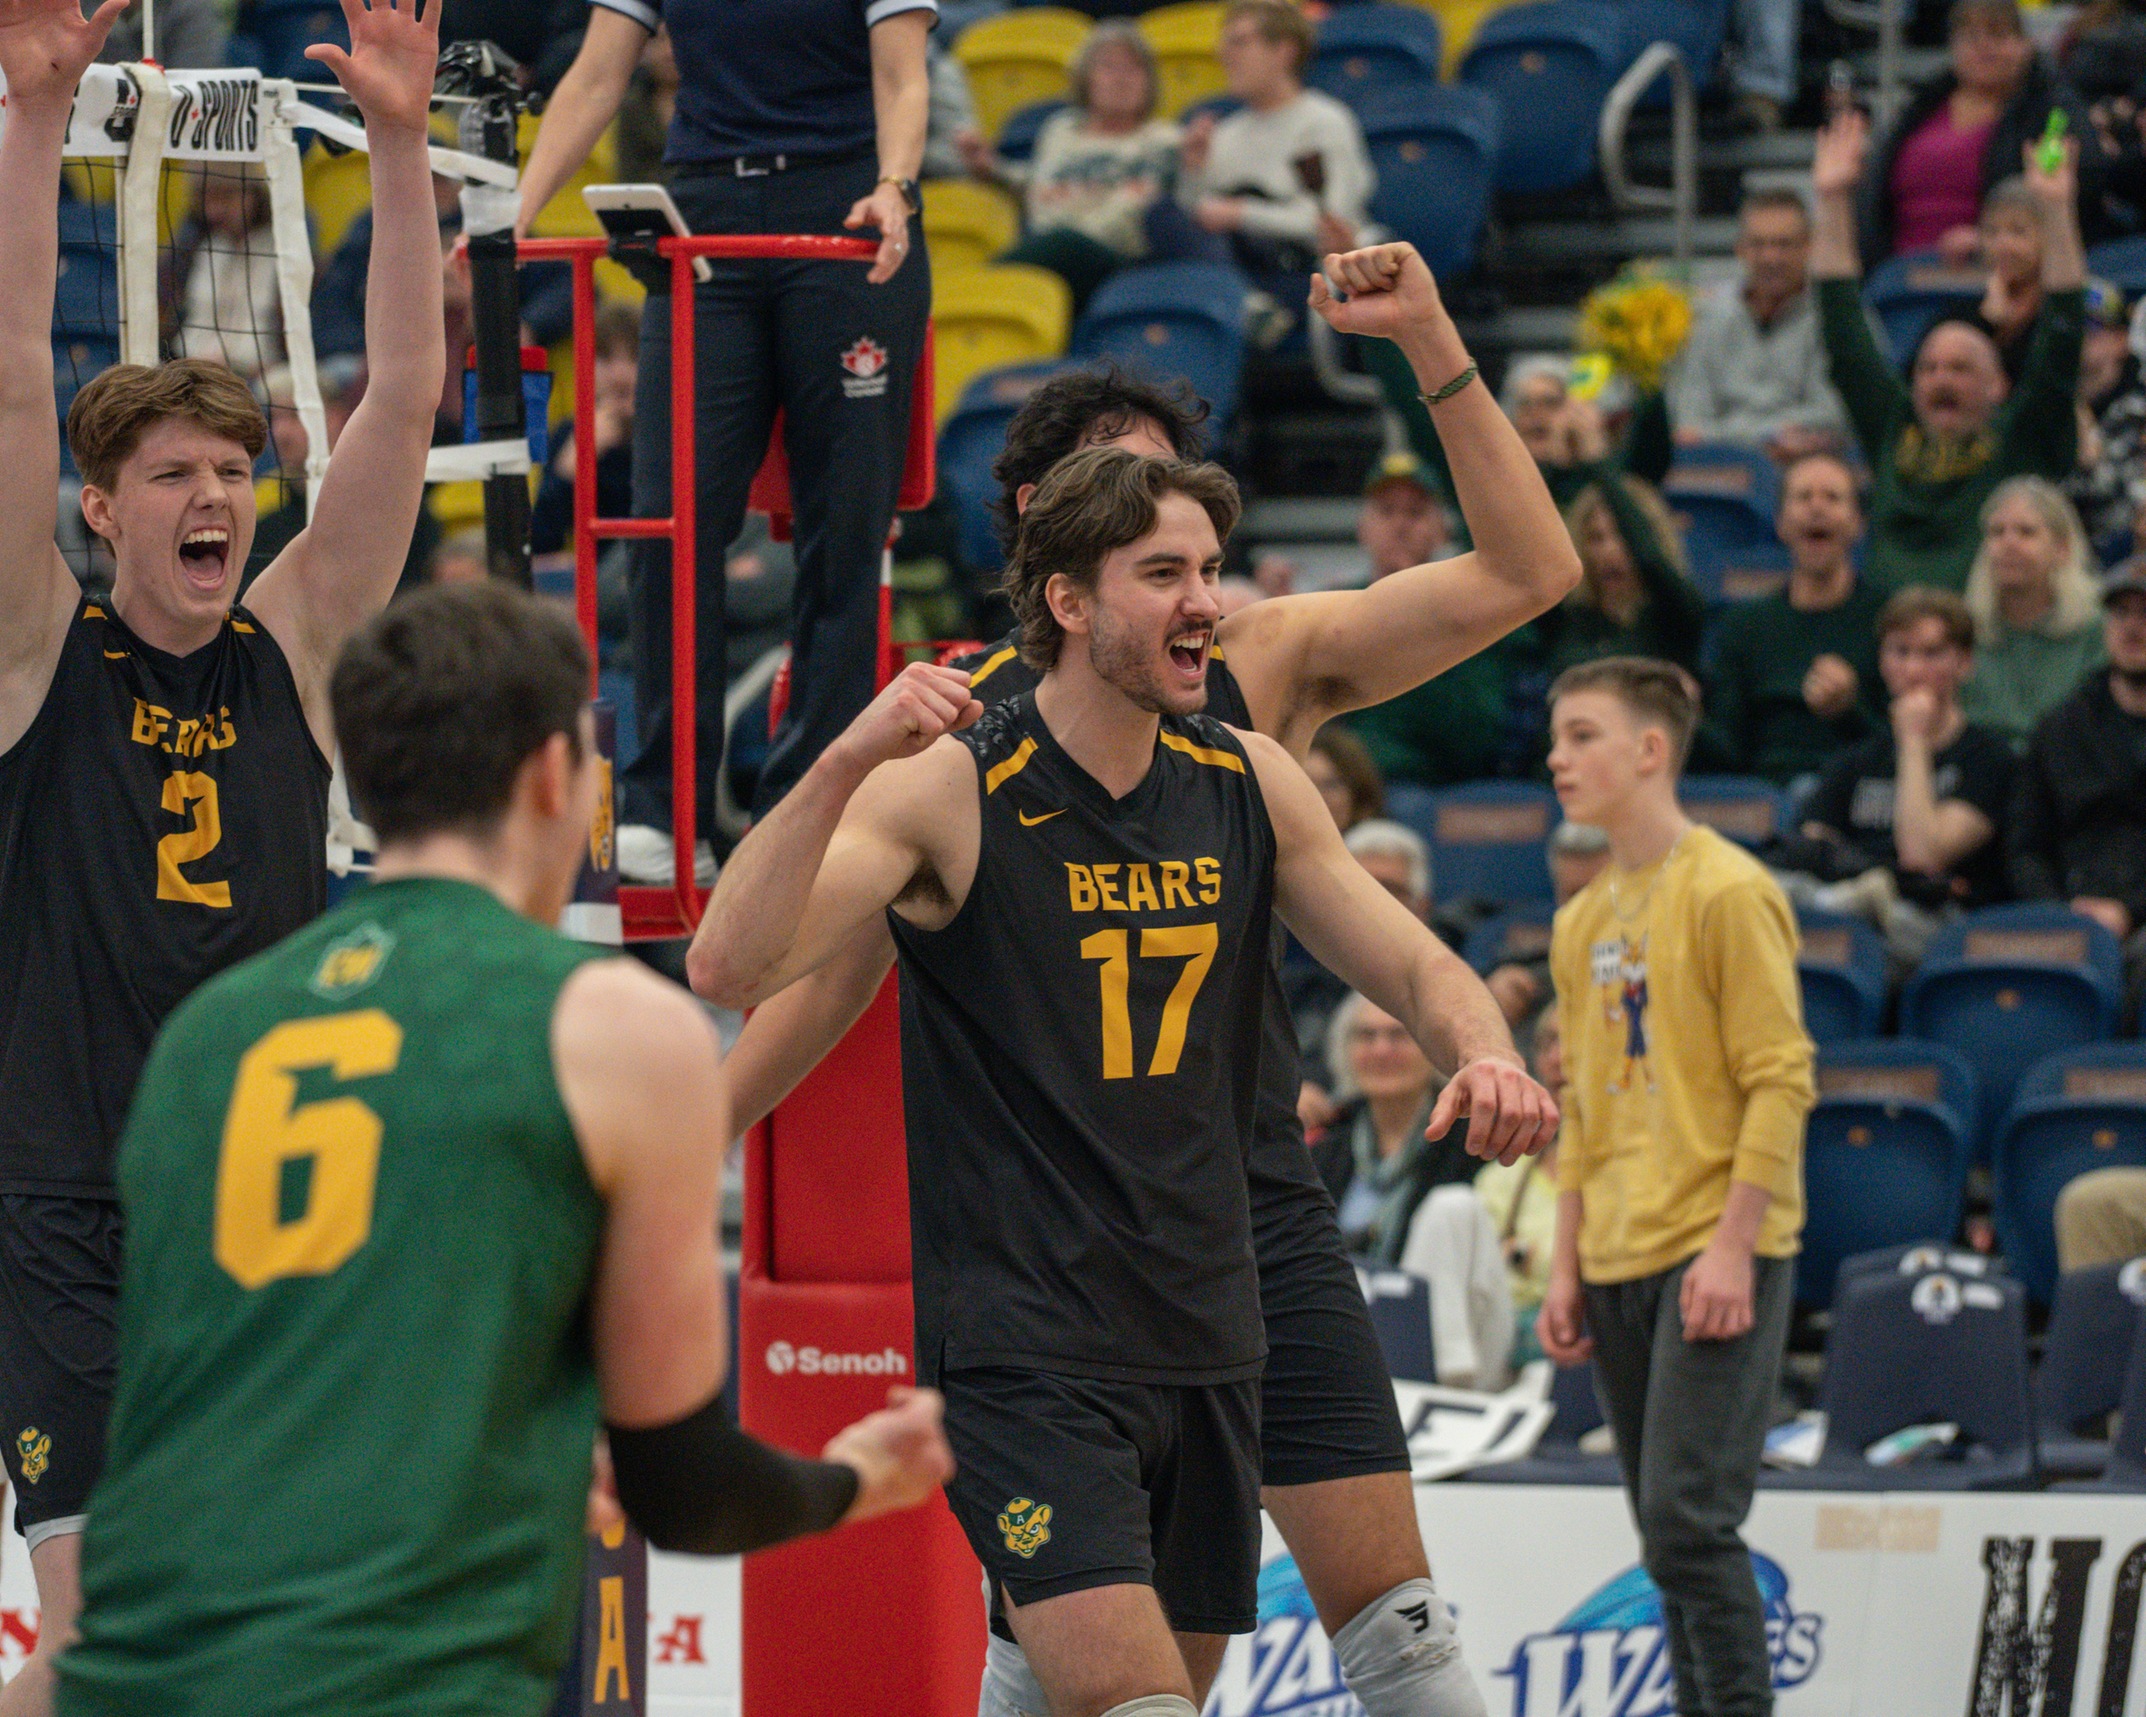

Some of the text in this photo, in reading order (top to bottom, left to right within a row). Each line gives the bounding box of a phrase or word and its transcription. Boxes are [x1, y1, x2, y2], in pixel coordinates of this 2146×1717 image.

[191, 80, 258, 152] SPORTS
[131, 697, 238, 758] BEARS
[156, 770, 232, 908] 2
[1063, 856, 1222, 912] BEARS
[1080, 922, 1219, 1079] 17
[213, 1008, 404, 1291] 6
[797, 1346, 908, 1376] Senoh
